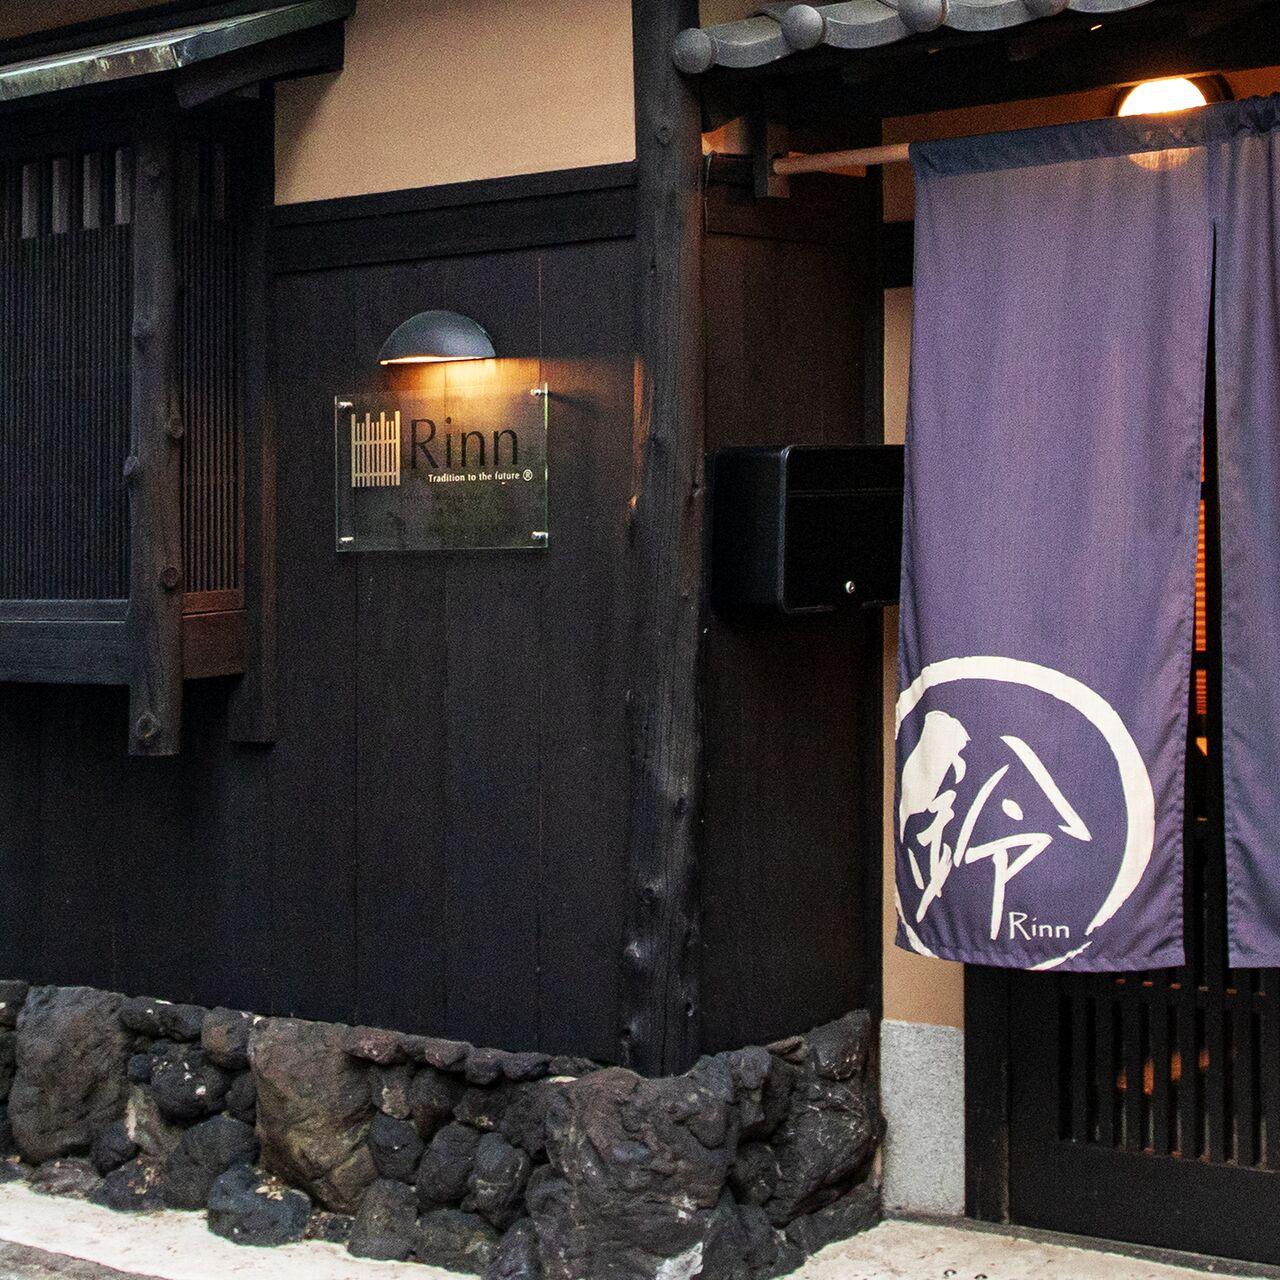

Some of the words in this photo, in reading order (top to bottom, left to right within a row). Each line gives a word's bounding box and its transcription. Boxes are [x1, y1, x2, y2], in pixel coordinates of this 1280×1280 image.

[411, 416, 518, 469] Rinn
[428, 472, 466, 483] Tradition
[467, 473, 477, 482] to
[479, 471, 492, 481] the
[495, 470, 520, 481] future
[1009, 911, 1070, 940] Rinn
